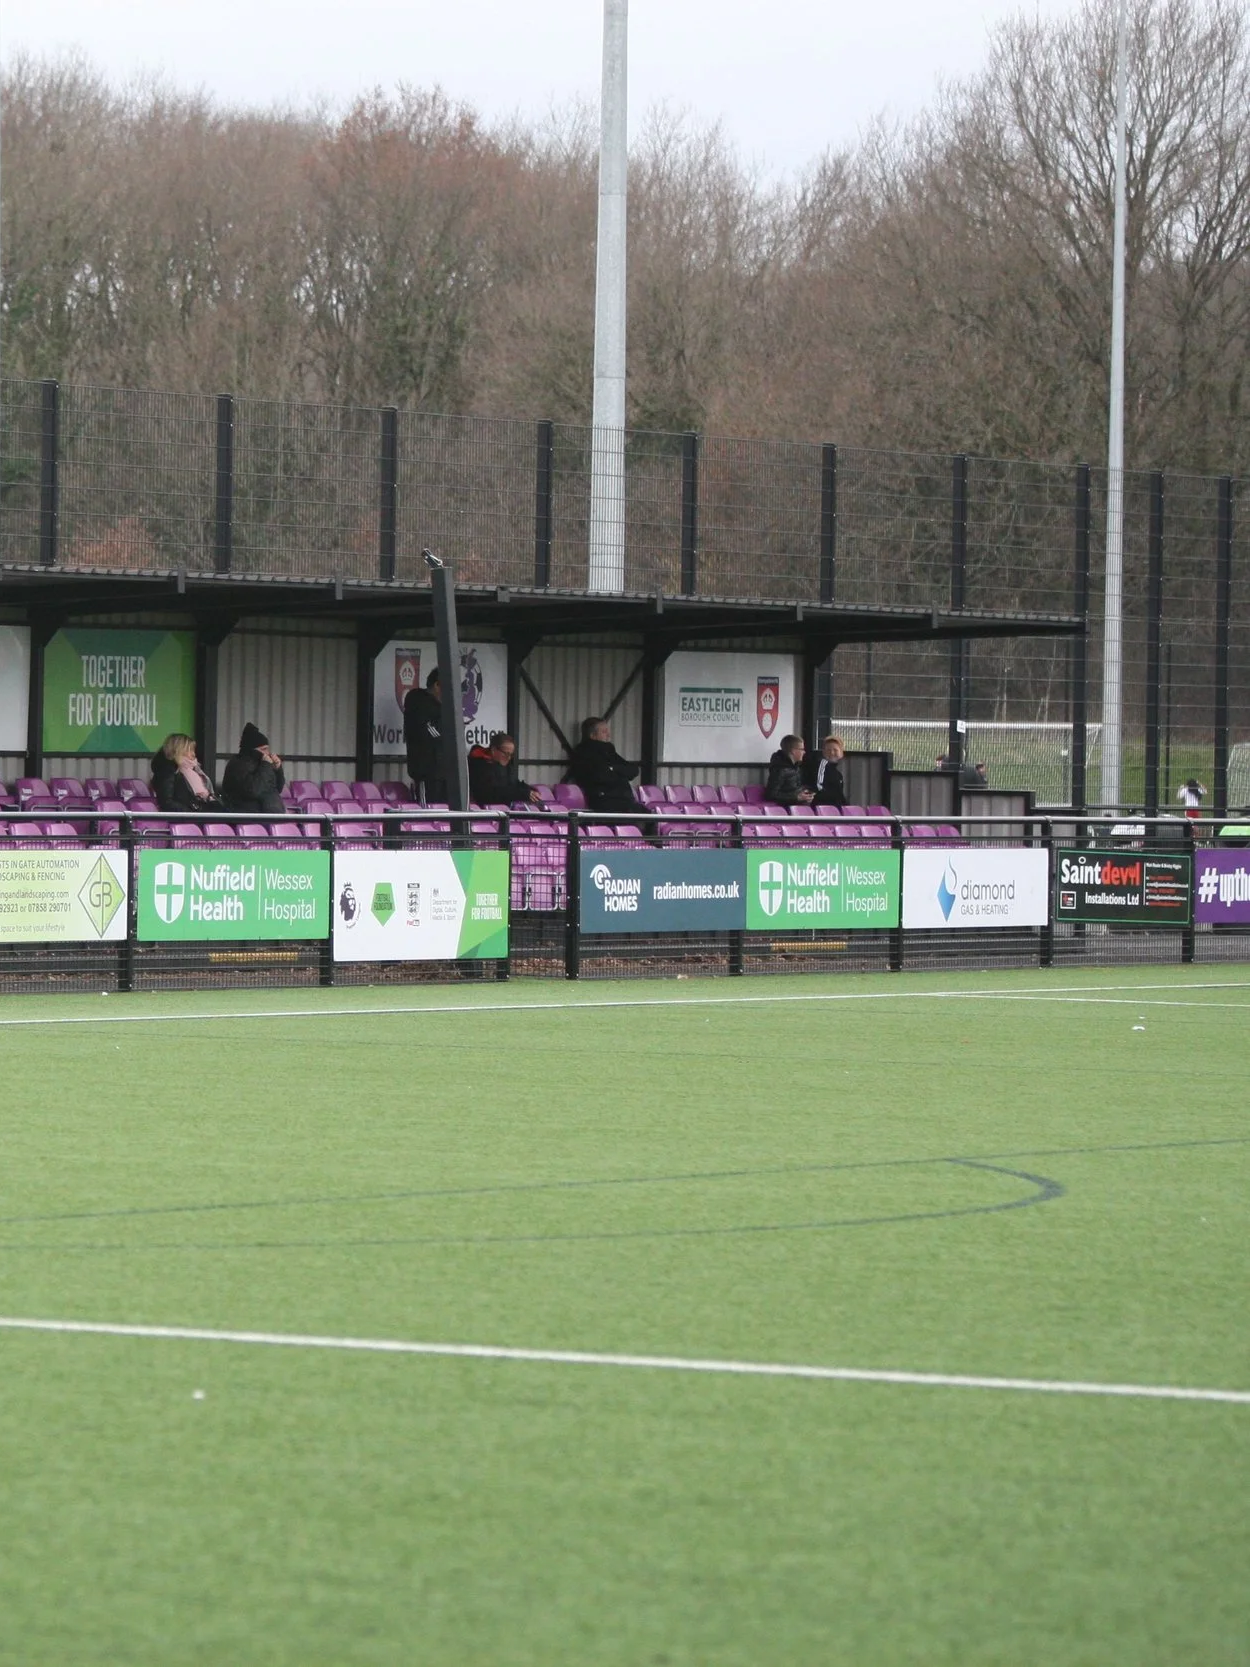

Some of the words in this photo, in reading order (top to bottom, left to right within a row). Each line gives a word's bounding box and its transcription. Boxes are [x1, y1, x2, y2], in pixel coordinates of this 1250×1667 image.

[81, 655, 145, 688] TOGETHER
[69, 693, 93, 726] FOR
[97, 693, 158, 726] FOOTBALL
[682, 697, 740, 712] EASTLEIGH
[681, 712, 710, 721] BOROUGH
[713, 713, 740, 722] COUNCIL
[10, 860, 18, 869] IN
[19, 860, 35, 869] GATE
[36, 860, 80, 869] AUTOMATION
[31, 872, 36, 881] &
[37, 872, 65, 881] FENCING
[190, 864, 255, 891] Nuffield
[264, 868, 313, 890] Wessex
[787, 862, 838, 886] Nuffield
[846, 866, 886, 884] Wessex
[89, 881, 113, 908] GB
[604, 879, 641, 895] RADIAN
[653, 881, 739, 900] radianhomes.co.uk
[961, 880, 1015, 900] diamond
[20, 905, 27, 913] or
[28, 903, 47, 913] 07858
[49, 902, 71, 913] 290701
[190, 895, 244, 921] Health
[476, 894, 498, 905] TOGETHER
[604, 896, 638, 912] HOMES
[787, 890, 830, 913] Health
[846, 892, 887, 917] Hospital
[1085, 892, 1126, 905] Installations
[1127, 893, 1140, 906] Ltd
[264, 899, 316, 926] Hospital
[471, 908, 481, 920] FOR
[481, 908, 502, 920] FOOTBALL
[961, 905, 974, 915] GAS
[976, 905, 979, 915] &
[982, 904, 1009, 915] HEATING
[1, 926, 15, 934] space
[33, 926, 44, 934] your
